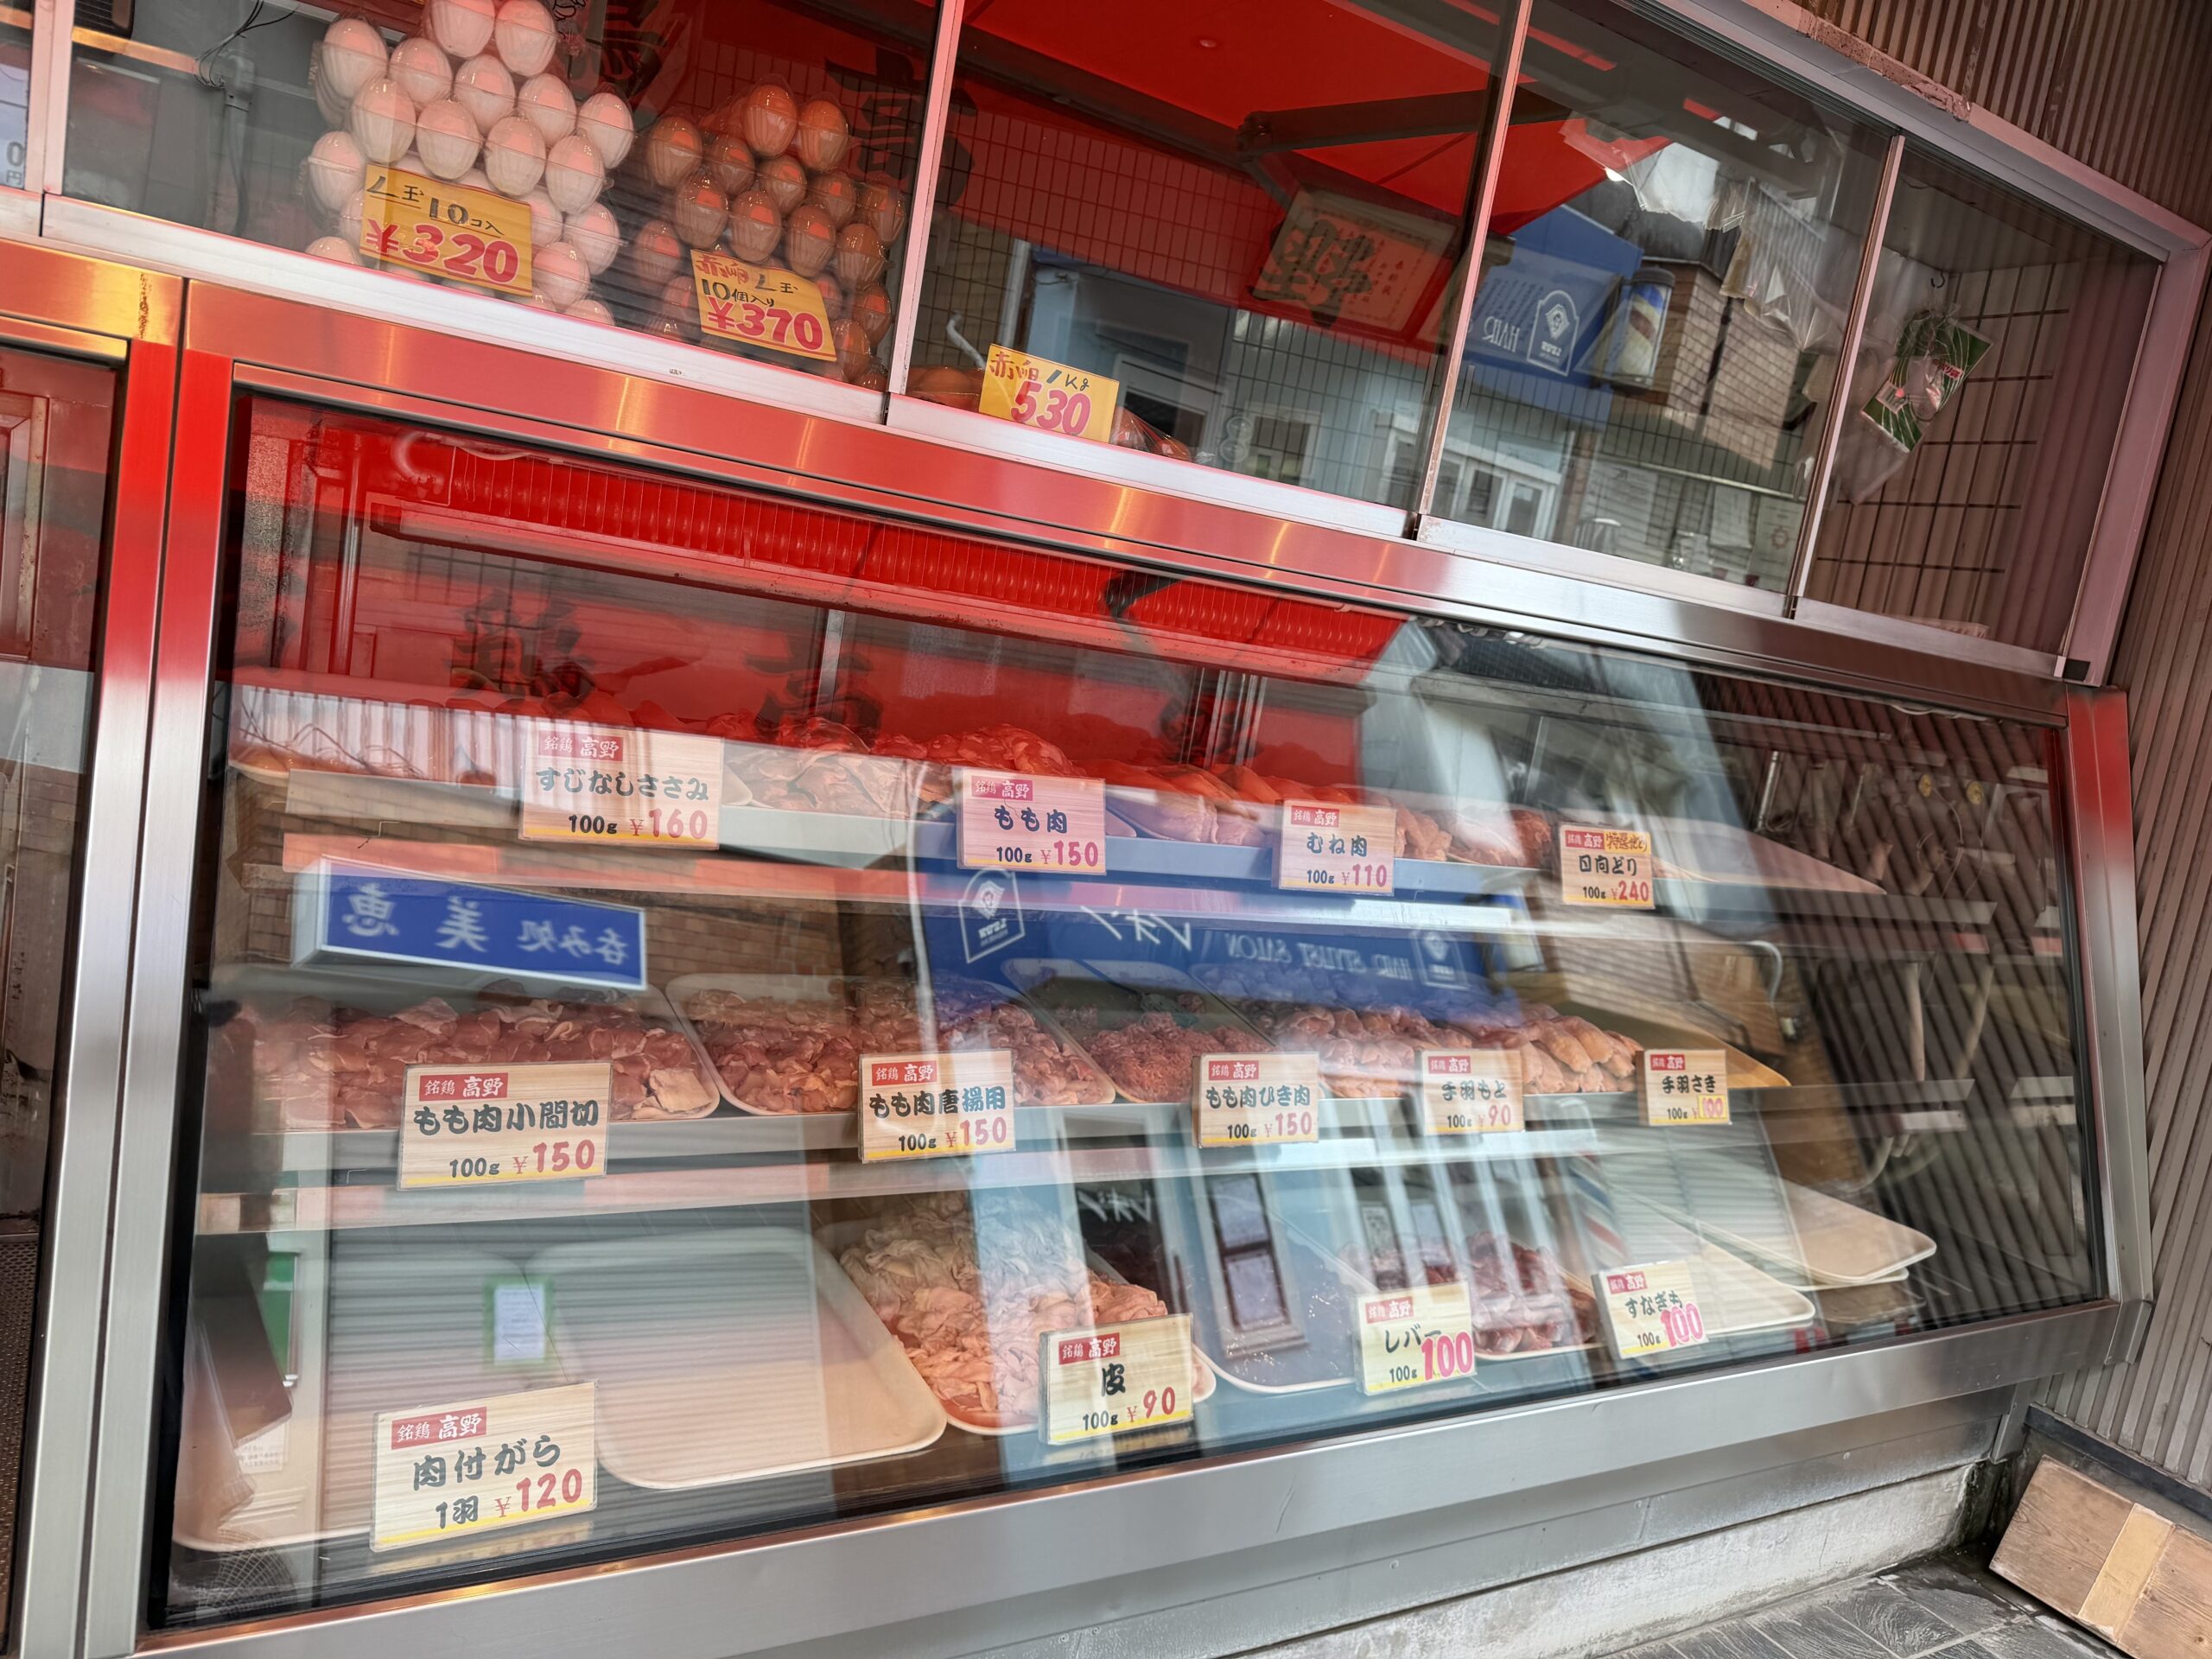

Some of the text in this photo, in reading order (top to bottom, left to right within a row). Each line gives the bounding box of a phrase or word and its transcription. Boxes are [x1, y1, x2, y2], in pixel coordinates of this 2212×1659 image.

[365, 219, 518, 283] ¥320
[707, 296, 823, 351] ¥370
[1010, 380, 1091, 436] 530
[544, 736, 620, 759] 銘鶏 高野
[536, 766, 709, 801] すじなしささみ
[1001, 779, 1030, 798] 高野
[569, 808, 708, 839] 100g ¥160
[995, 804, 1067, 834] もも肉
[1314, 809, 1337, 826] 高野
[996, 840, 1098, 867] 100g ¥150
[1306, 832, 1367, 857] むね肉
[1307, 863, 1388, 887] 100g ¥110
[1579, 855, 1637, 876] 日向どり
[1583, 880, 1649, 901] 100g ¥240
[875, 1064, 934, 1082] 銘鶏 高野
[1233, 1062, 1257, 1078] 高野
[1662, 1075, 1716, 1094] 手羽さき
[424, 1076, 503, 1097] 銘鶏 高野
[1205, 1084, 1311, 1109] もも肉ひき肉
[1441, 1080, 1507, 1102] 手羽もと
[869, 1085, 1006, 1119] もも肉唐揚用
[1667, 1108, 1688, 1120] 100g
[413, 1099, 599, 1135] もも肉小間切
[1227, 1111, 1313, 1139] 100g ¥150
[899, 1116, 1007, 1151] 100g ¥150
[449, 1139, 595, 1178] 100g ¥150
[1385, 1322, 1441, 1353] レバー
[1637, 1303, 1704, 1348] 100g 100
[1089, 1338, 1116, 1357] 高野
[1389, 1331, 1473, 1382] 100g 100
[1102, 1363, 1126, 1396] 皮
[1083, 1386, 1176, 1431] 100g ¥90
[397, 1413, 481, 1442] 銘鶏 高野
[413, 1434, 561, 1491] 肉付がら
[435, 1469, 582, 1529] 1羽 ¥120
